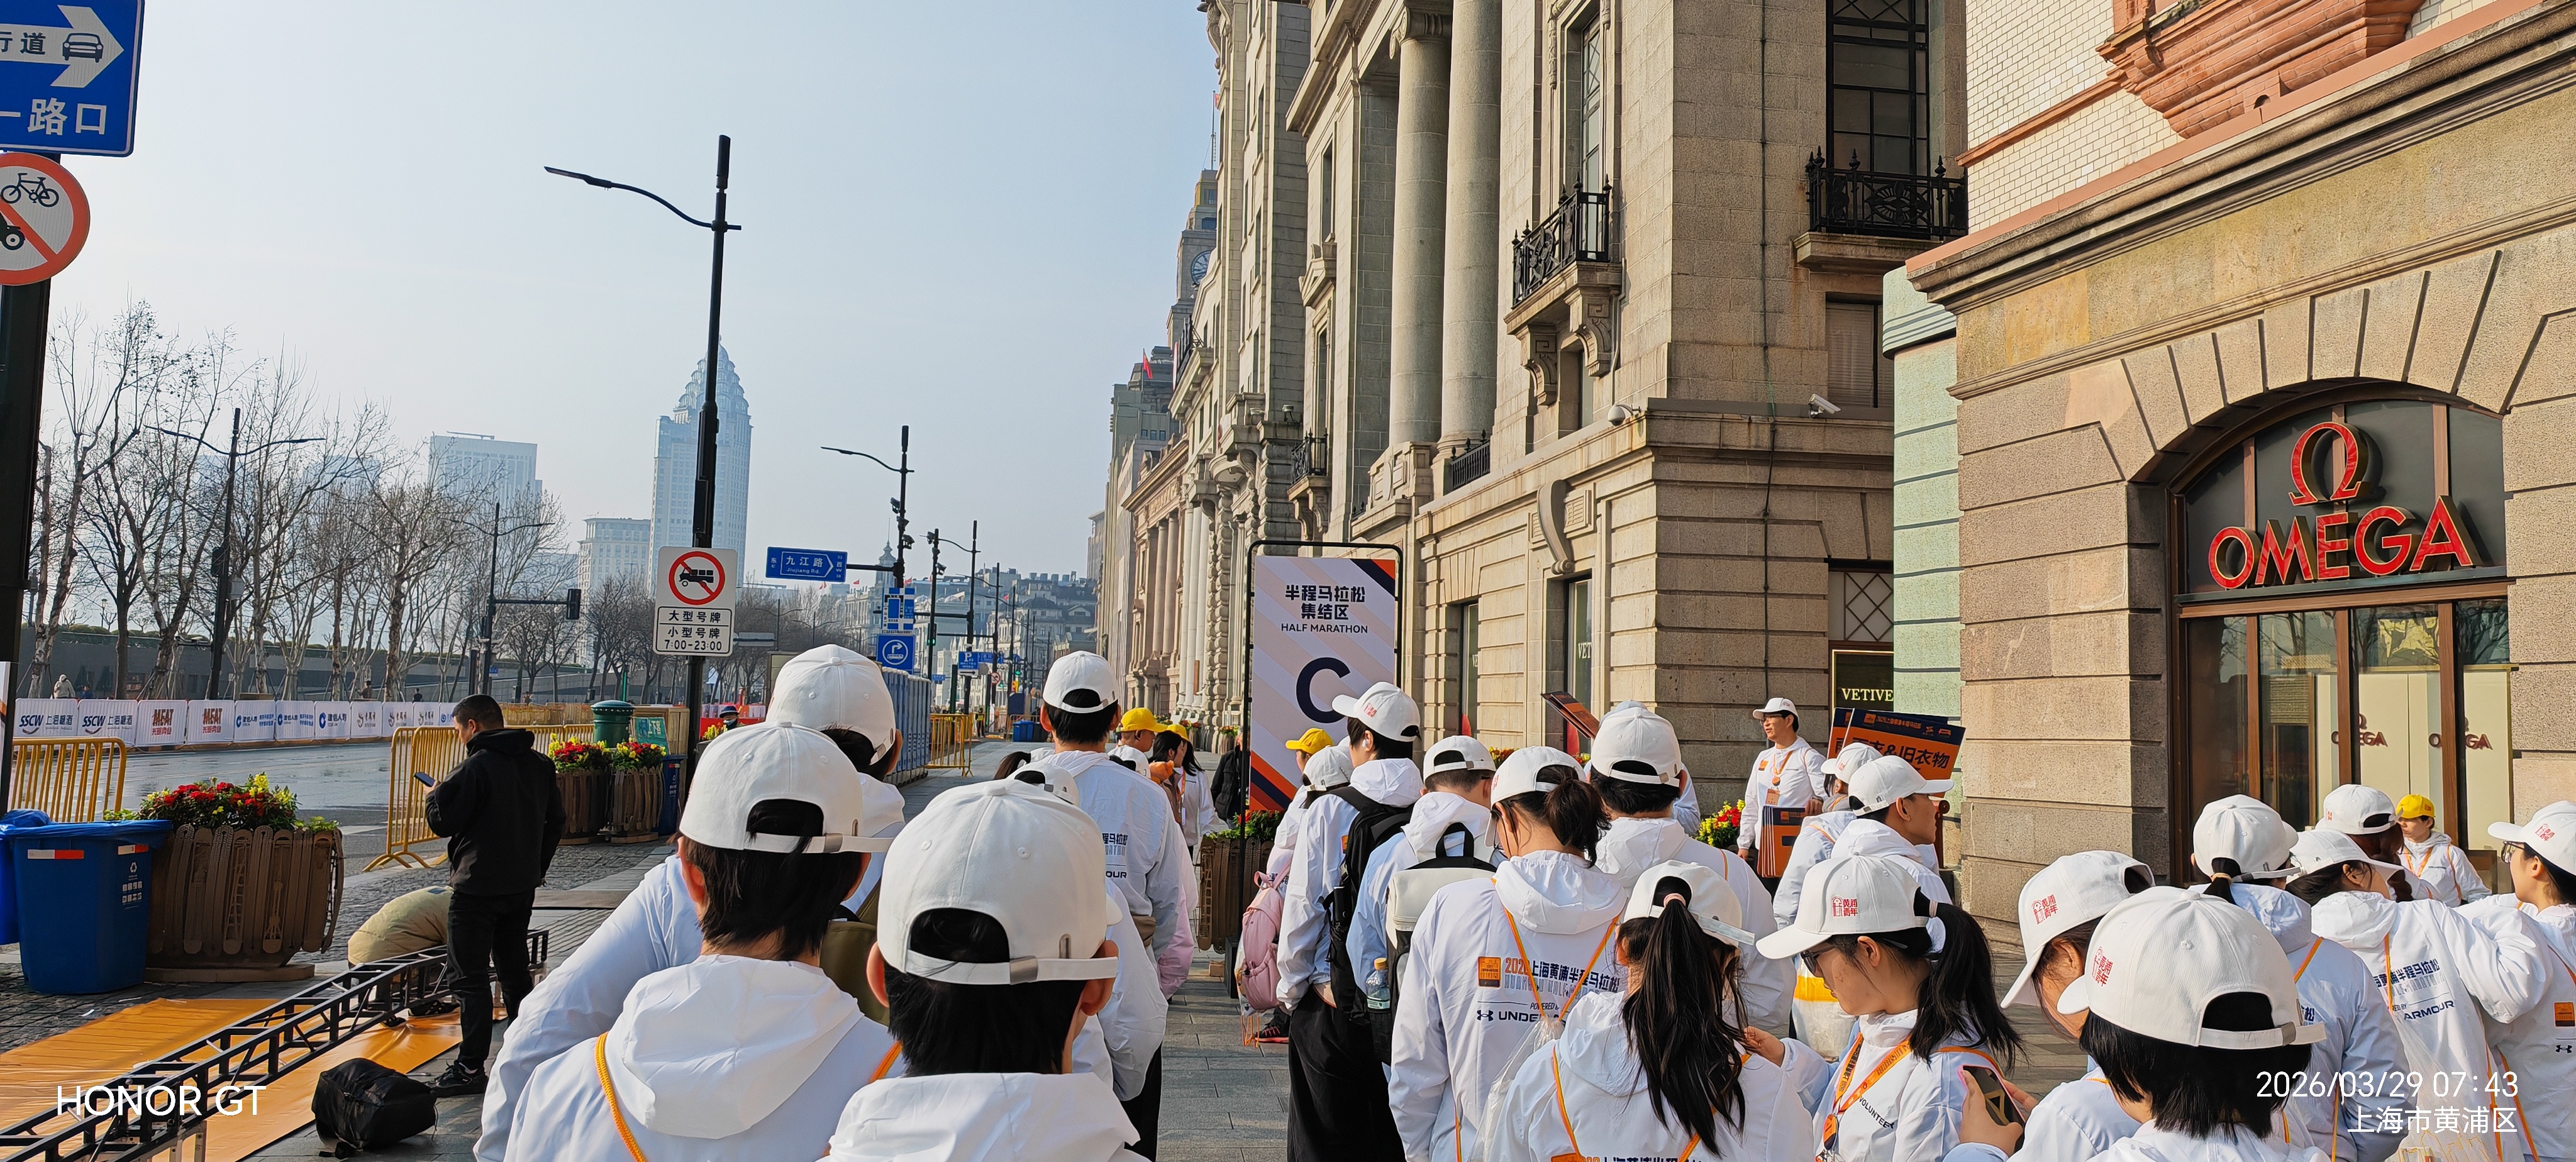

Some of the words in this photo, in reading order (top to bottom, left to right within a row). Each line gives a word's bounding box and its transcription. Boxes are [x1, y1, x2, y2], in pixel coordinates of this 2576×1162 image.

[2208, 495, 2475, 589] OMEGA
[786, 556, 823, 567] 九江路
[1285, 584, 1365, 603] 半程马拉松
[669, 609, 721, 623] 大型号牌
[1301, 604, 1349, 621] 集结区
[667, 626, 720, 639] 小型号牌
[1281, 623, 1307, 632] HALF
[1309, 624, 1368, 633] MARATHON
[664, 639, 722, 651] 7:00-23:00
[964, 652, 972, 662] P
[1296, 657, 1350, 724] C
[1841, 688, 1894, 702] VETIVE
[19, 715, 44, 727] SSCW
[82, 715, 106, 728] SSCW
[2331, 731, 2388, 747] OEGA
[2429, 733, 2493, 750] OGA
[1499, 1011, 1541, 1022] UNDE
[2404, 1000, 2455, 1021] ARMOUR
